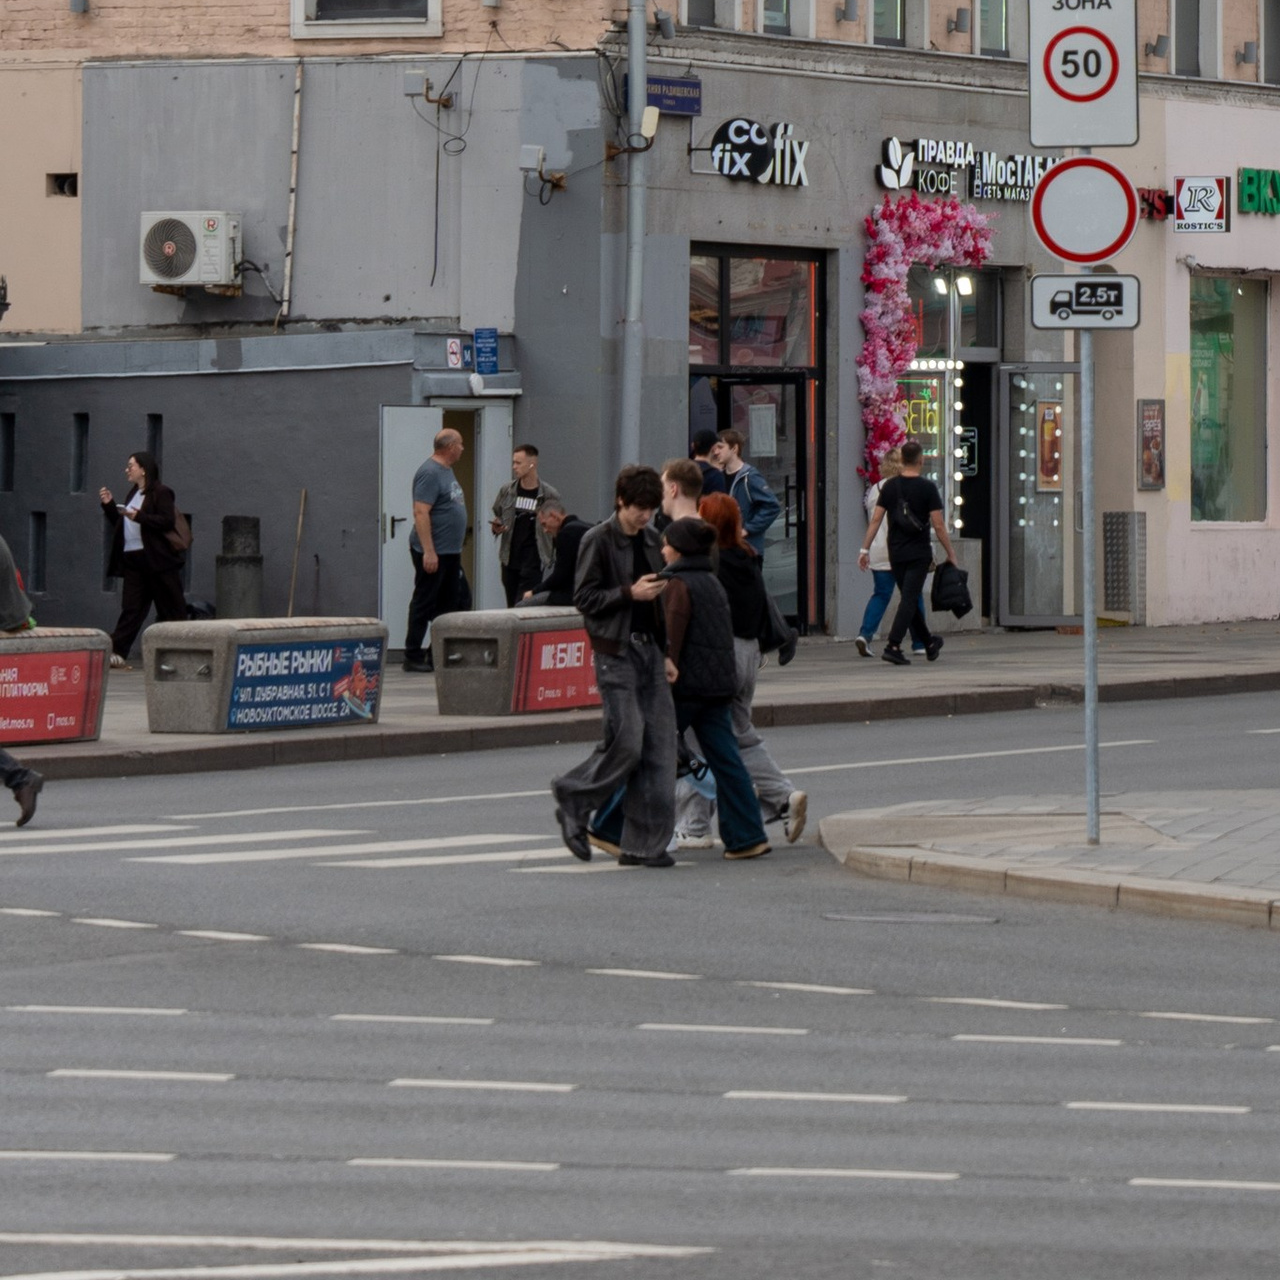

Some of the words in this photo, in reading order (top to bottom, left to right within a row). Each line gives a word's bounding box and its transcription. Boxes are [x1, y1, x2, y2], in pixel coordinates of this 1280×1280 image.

[1061, 49, 1102, 79] 50
[712, 143, 751, 176] fix
[918, 138, 975, 169] ПРАВДА
[918, 169, 957, 194] КОФЕ
[983, 185, 1002, 199] СЕТЬ
[1176, 222, 1224, 231] ROSTIC'S
[236, 650, 290, 678] РЫБНЫЕ
[291, 648, 333, 675] РЫНКИ
[239, 686, 253, 702] УЛ.
[236, 704, 310, 724] НОВОУХТОМСКОЕ
